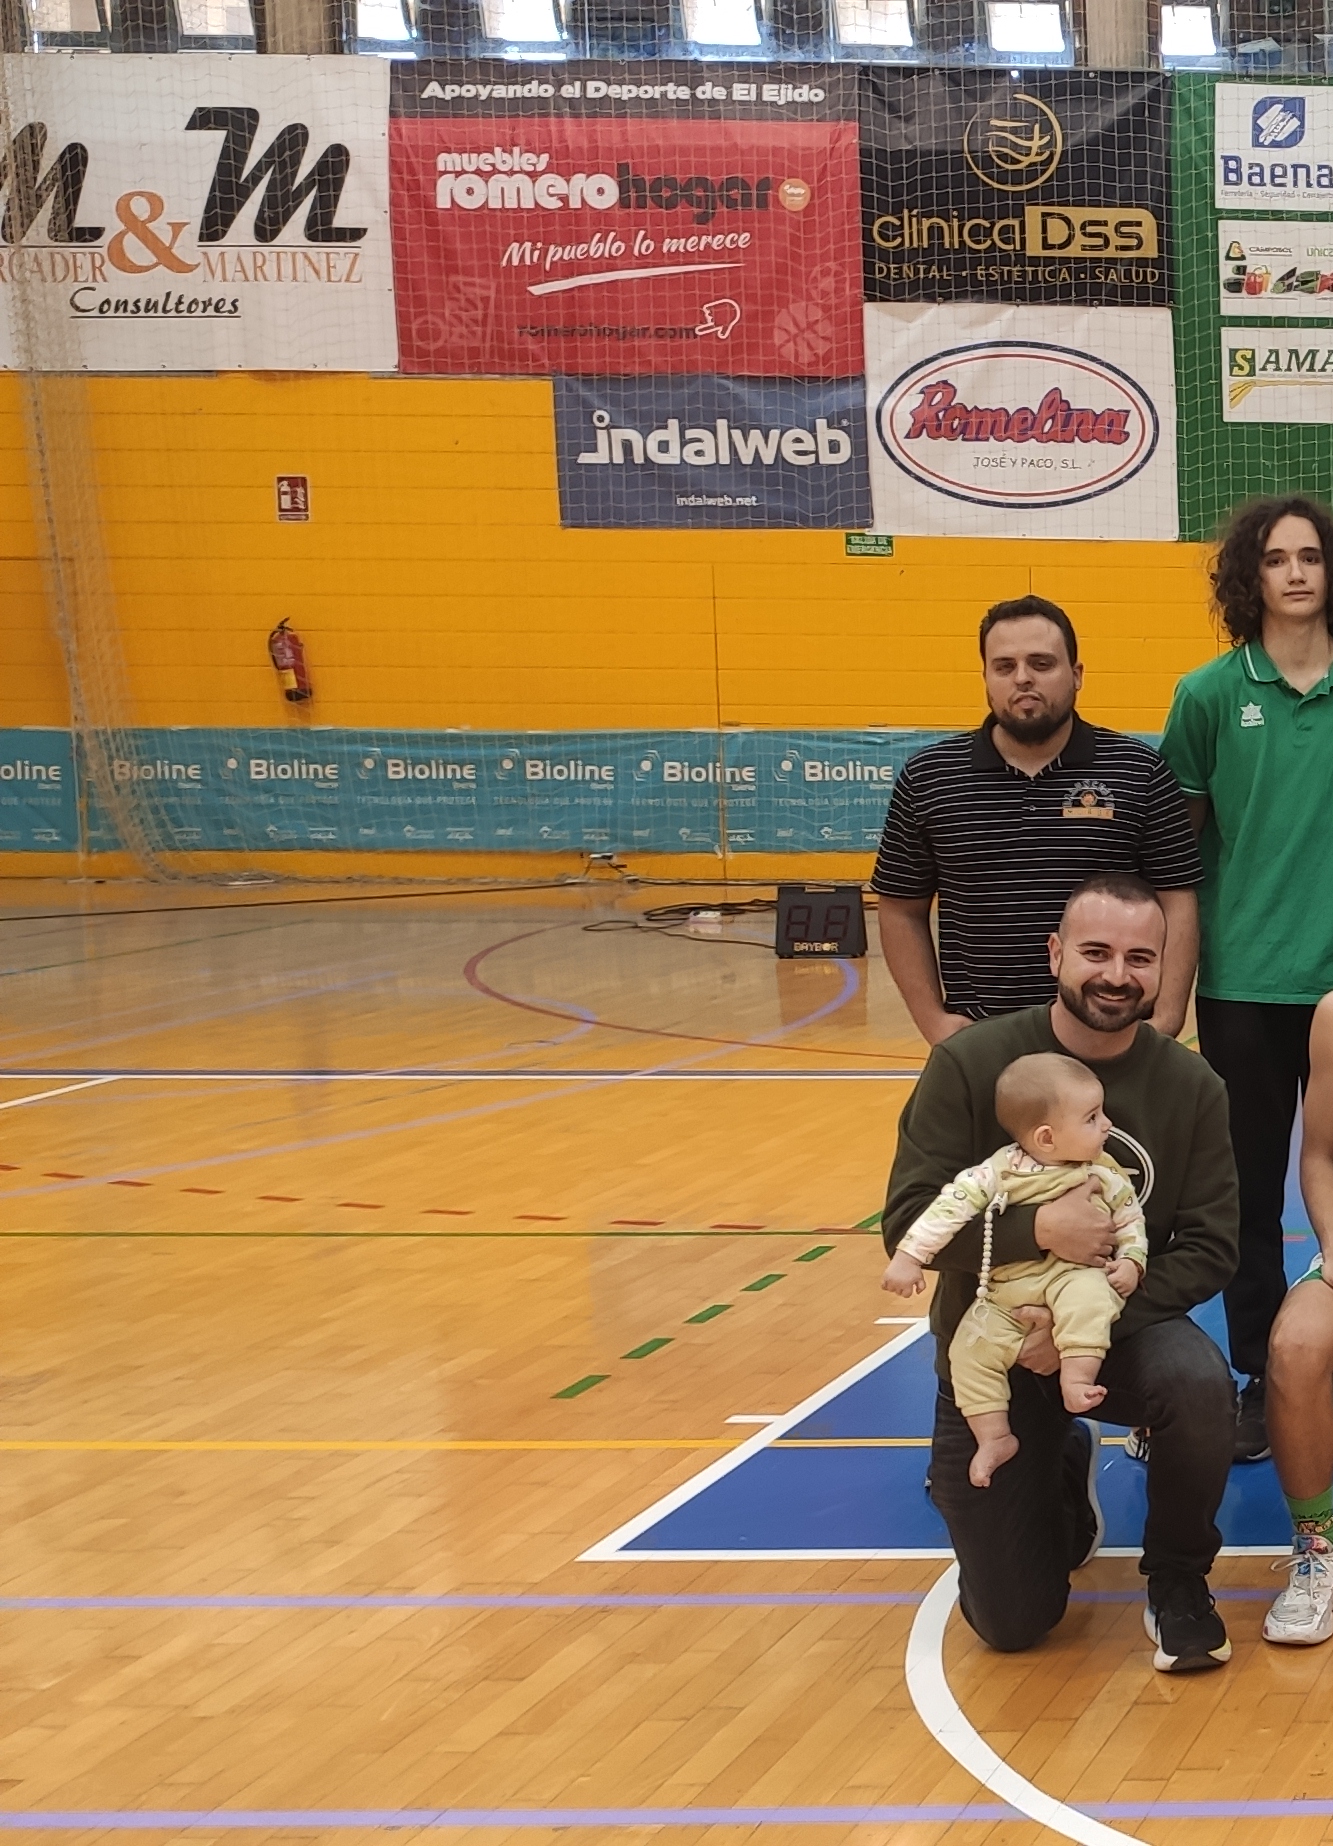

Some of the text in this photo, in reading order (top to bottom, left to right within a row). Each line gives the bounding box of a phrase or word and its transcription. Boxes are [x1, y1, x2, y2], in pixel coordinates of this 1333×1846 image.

[420, 80, 825, 105] Apoyando el Deporte de El Ejido
[437, 147, 549, 172] muebles
[107, 106, 368, 274] & M
[501, 229, 751, 272] Mi pueblo lo merece
[203, 251, 362, 283] MARTINEZ
[874, 263, 1159, 284] DENTAL ESTÉTICA SALUD
[70, 286, 240, 315] Consultores
[904, 380, 1132, 445] Romelina
[577, 409, 852, 465] indalweb
[1009, 457, 1018, 468] Y
[675, 494, 758, 508] indalweb.net
[114, 759, 202, 780] Bioline
[250, 758, 340, 780] Bioline
[387, 758, 477, 780] Bioline
[525, 759, 615, 781] Bioline
[664, 761, 756, 783] Bioline
[804, 760, 893, 782] Bioline
